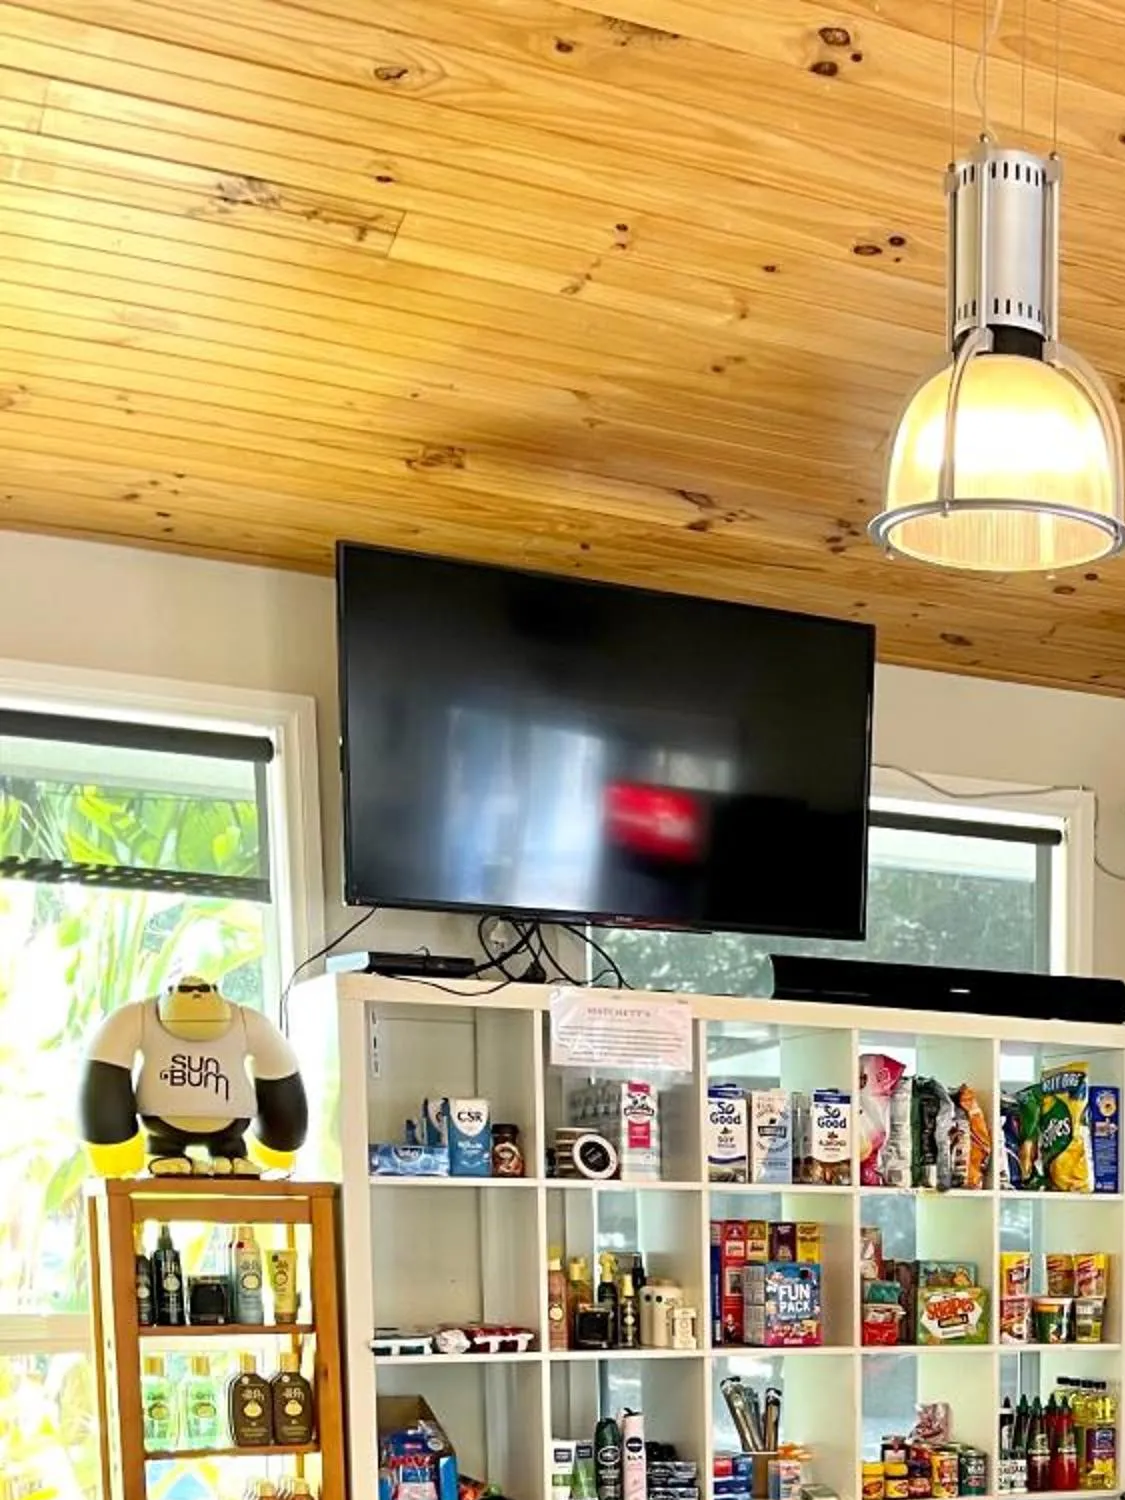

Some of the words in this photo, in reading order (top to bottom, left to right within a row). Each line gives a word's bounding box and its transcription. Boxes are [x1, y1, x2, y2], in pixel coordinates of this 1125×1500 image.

[457, 1111, 483, 1124] CSR
[709, 1113, 741, 1125] Good
[817, 1117, 847, 1129] Good
[779, 1284, 811, 1301] FUN
[779, 1301, 811, 1313] PACK
